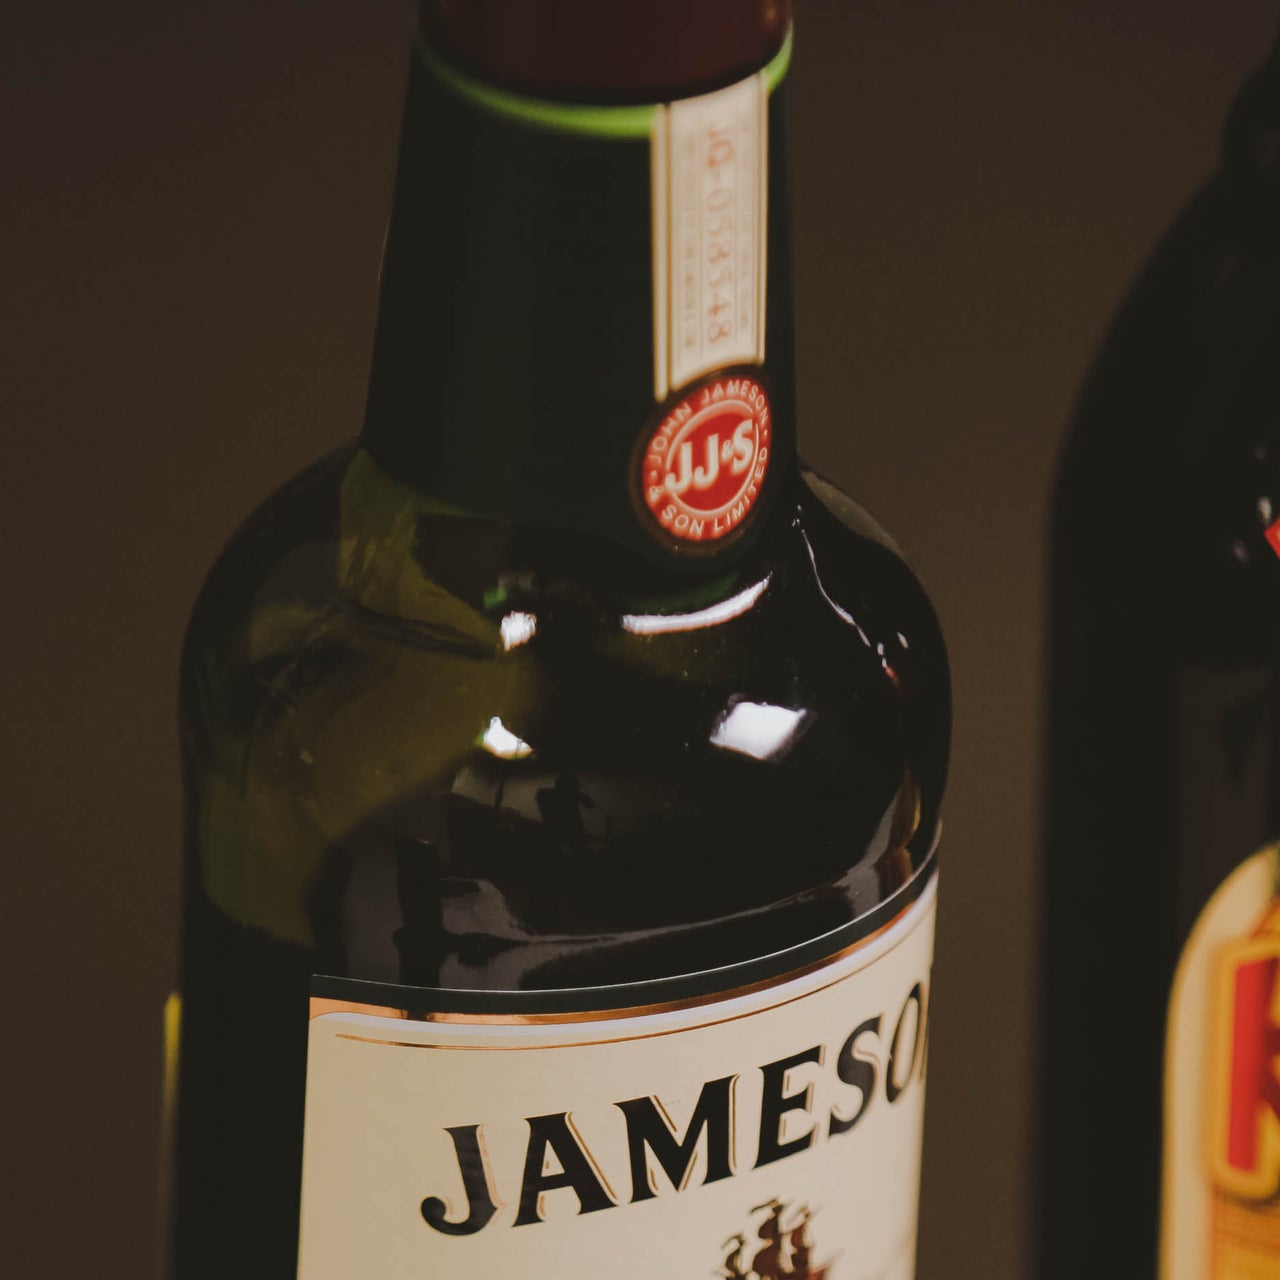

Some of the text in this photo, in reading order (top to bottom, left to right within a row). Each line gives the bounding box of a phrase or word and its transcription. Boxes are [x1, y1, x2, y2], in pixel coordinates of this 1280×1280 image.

[702, 378, 769, 424] JAMESON
[648, 402, 693, 465] JOHN
[665, 418, 754, 497] JJ&S
[661, 503, 705, 536] SON
[713, 446, 768, 535] LIMITED
